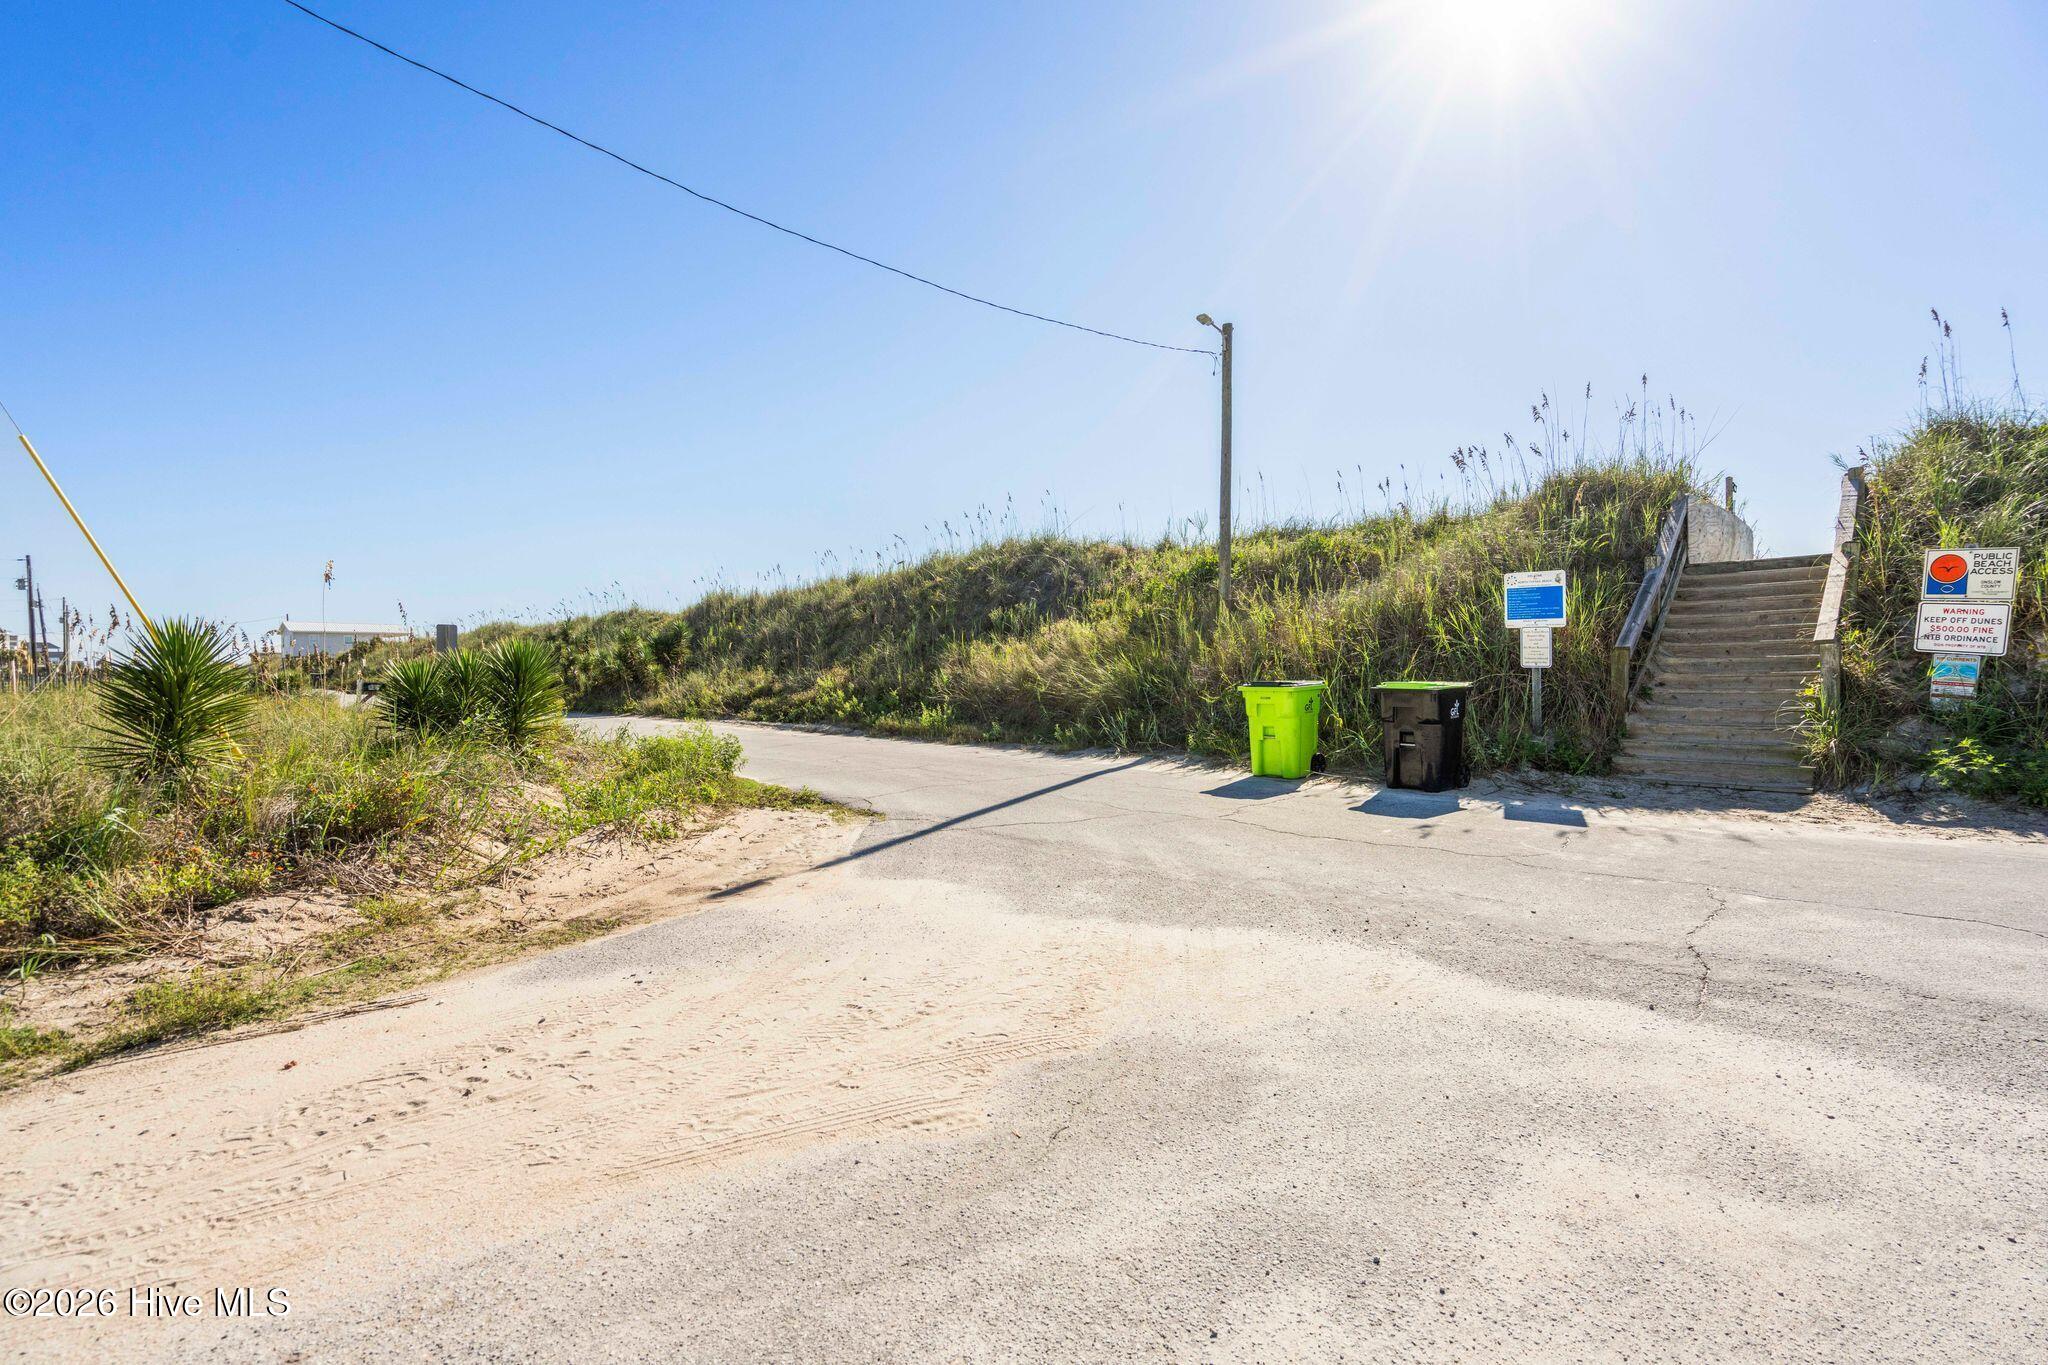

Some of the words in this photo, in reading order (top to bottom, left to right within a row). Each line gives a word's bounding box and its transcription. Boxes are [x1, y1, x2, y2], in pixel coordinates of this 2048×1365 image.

[1973, 552, 2013, 560] PUBLIC
[1973, 560, 2012, 568] BEACH
[1970, 567, 2014, 575] ACCESS
[1930, 625, 1969, 633] $500.00
[1923, 633, 1941, 641] NTB
[1944, 634, 1998, 644] ORDINANCE
